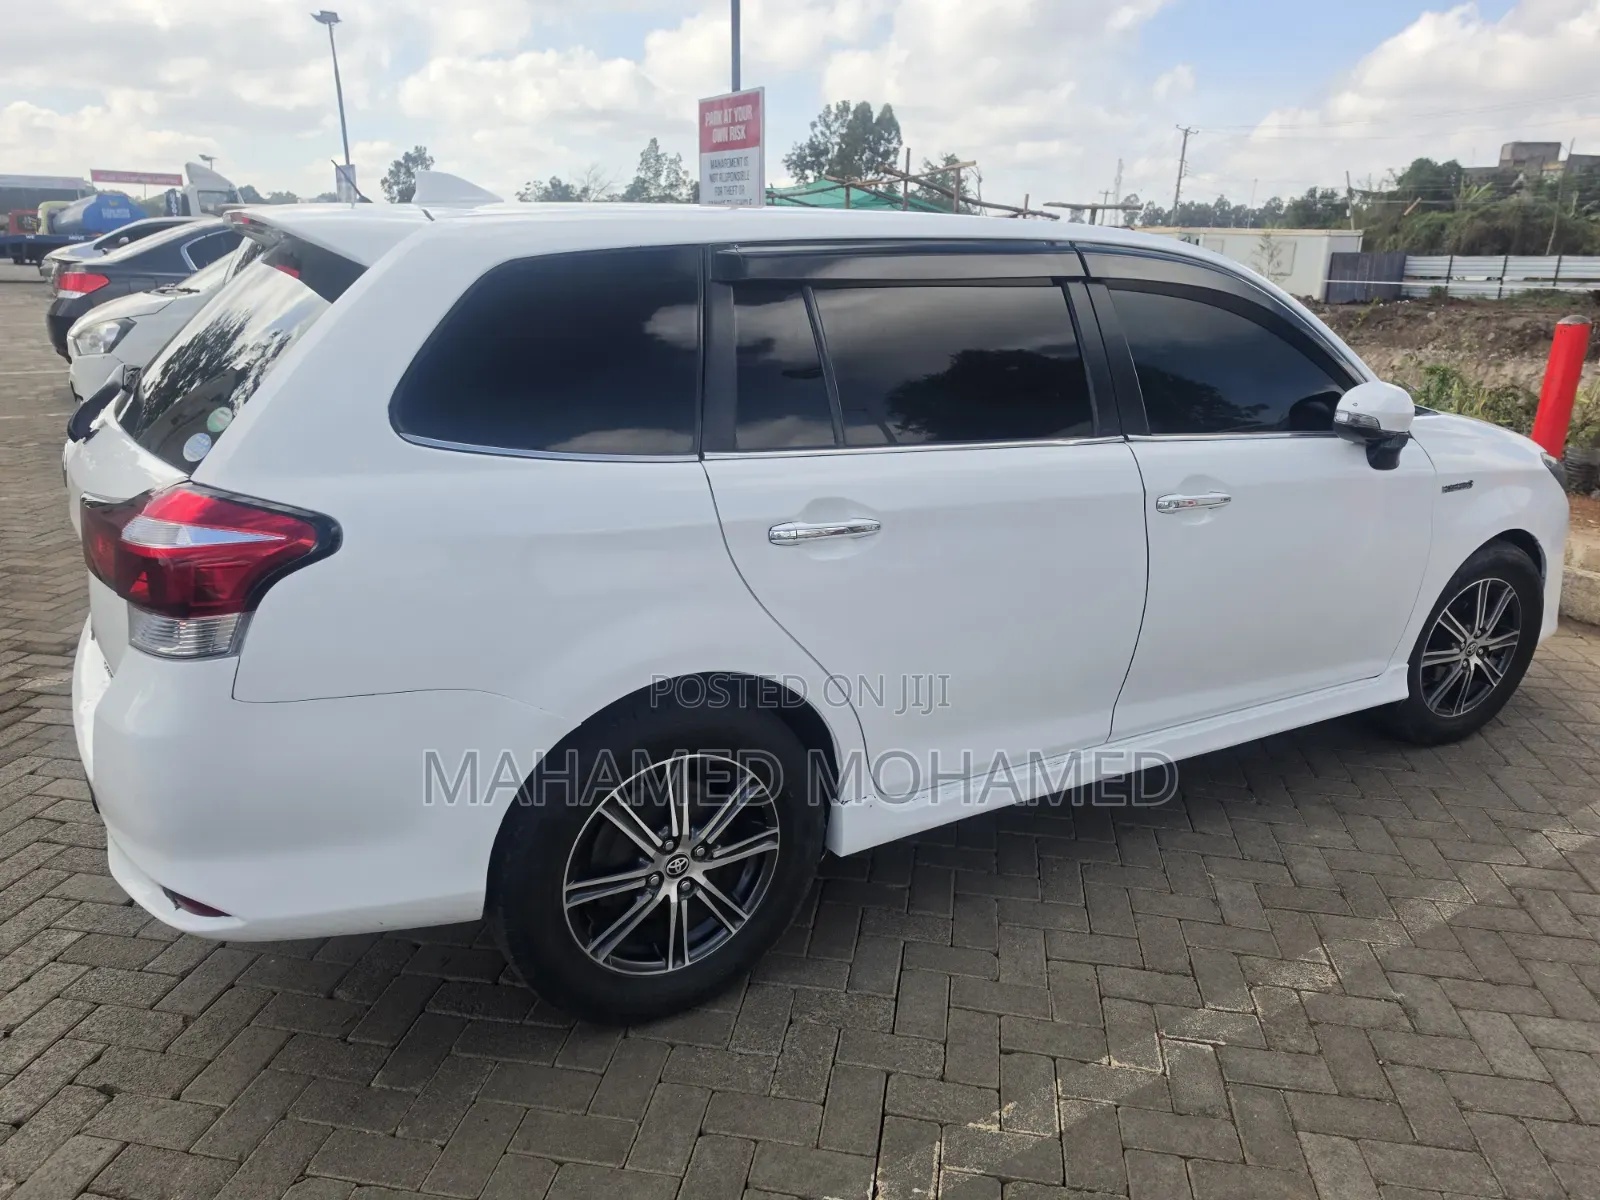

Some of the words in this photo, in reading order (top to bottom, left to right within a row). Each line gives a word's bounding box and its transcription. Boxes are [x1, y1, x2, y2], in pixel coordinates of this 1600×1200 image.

[705, 111, 723, 127] PARK
[723, 108, 732, 124] AT
[733, 105, 753, 122] YOUR
[712, 127, 728, 143] OWN
[729, 125, 746, 141] RISK
[710, 157, 743, 169] MANAGEMENT
